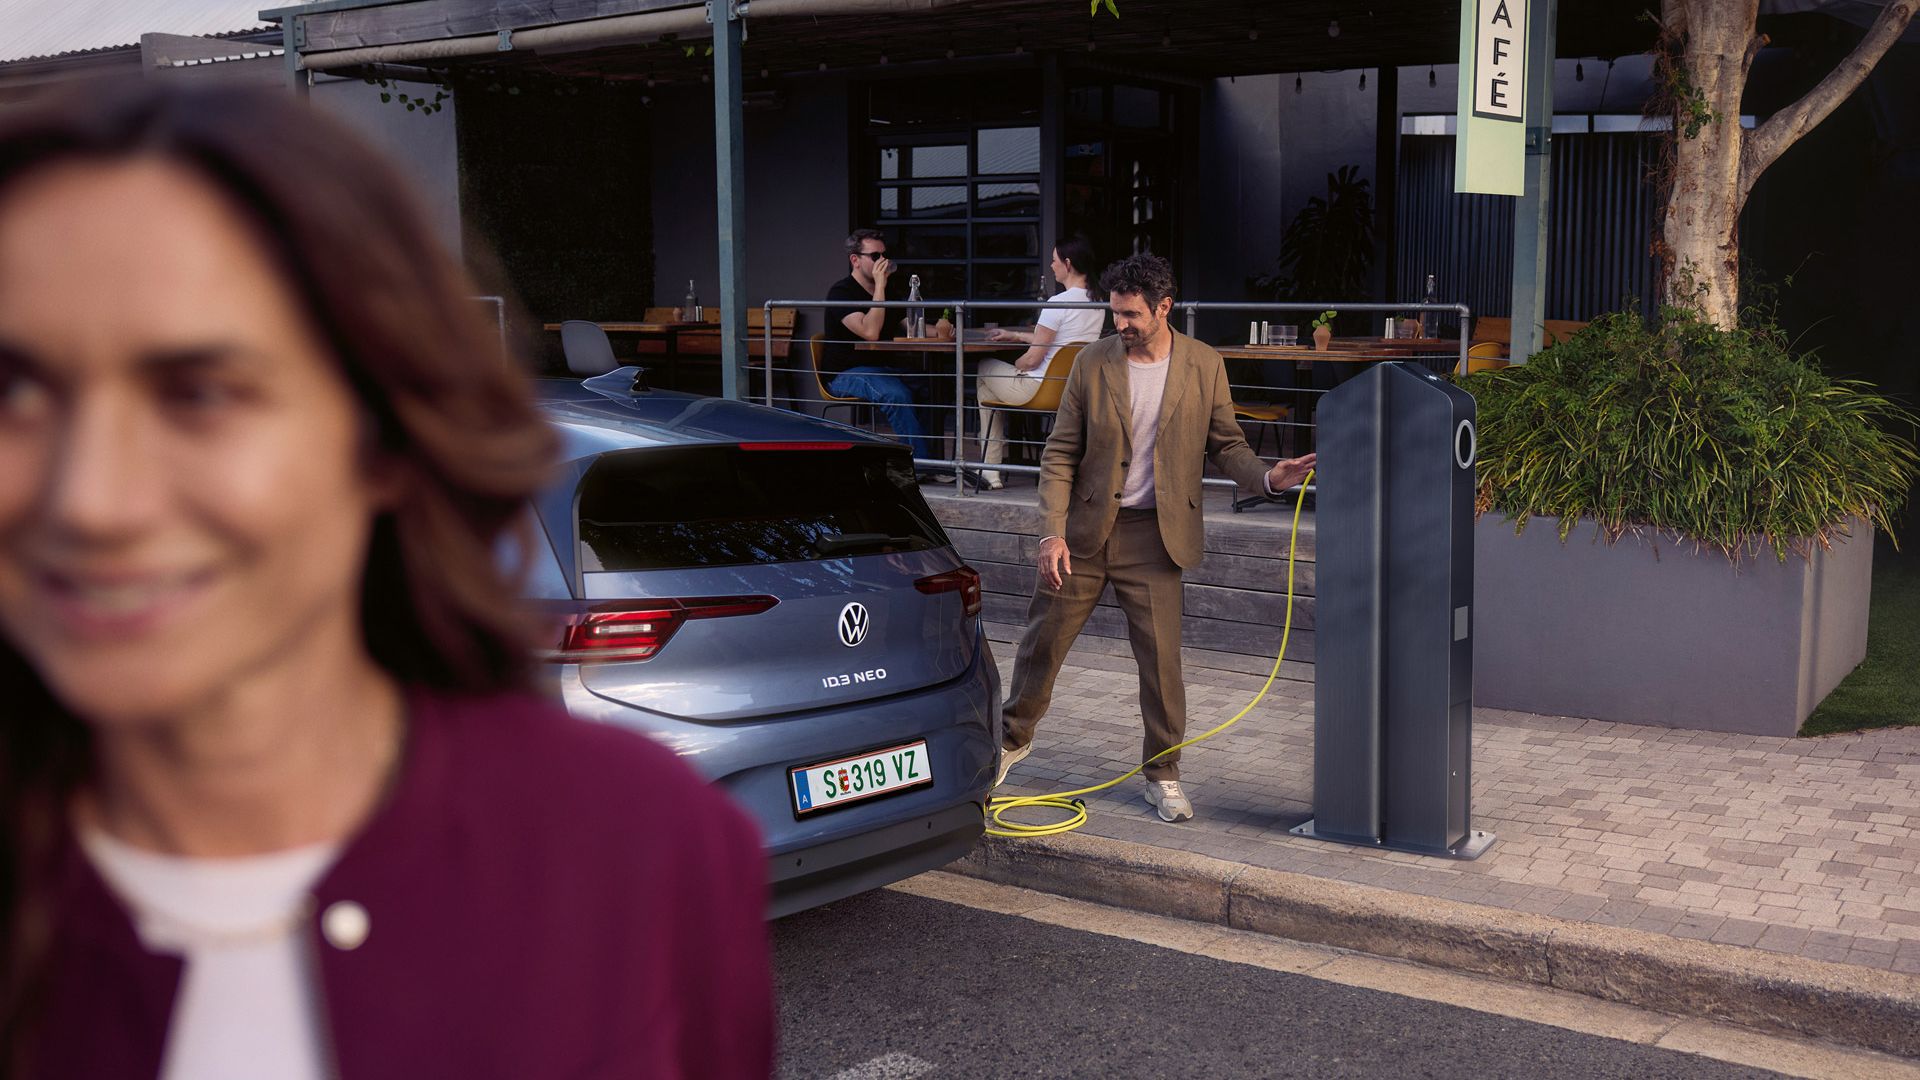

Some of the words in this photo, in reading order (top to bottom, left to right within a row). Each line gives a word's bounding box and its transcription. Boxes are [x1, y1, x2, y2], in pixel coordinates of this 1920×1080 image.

[841, 603, 869, 646] VW
[822, 674, 850, 688] ID.3
[853, 668, 887, 684] NEO
[823, 769, 837, 798] S
[851, 758, 886, 792] 319
[892, 750, 919, 781] VZ
[802, 794, 809, 804] A
